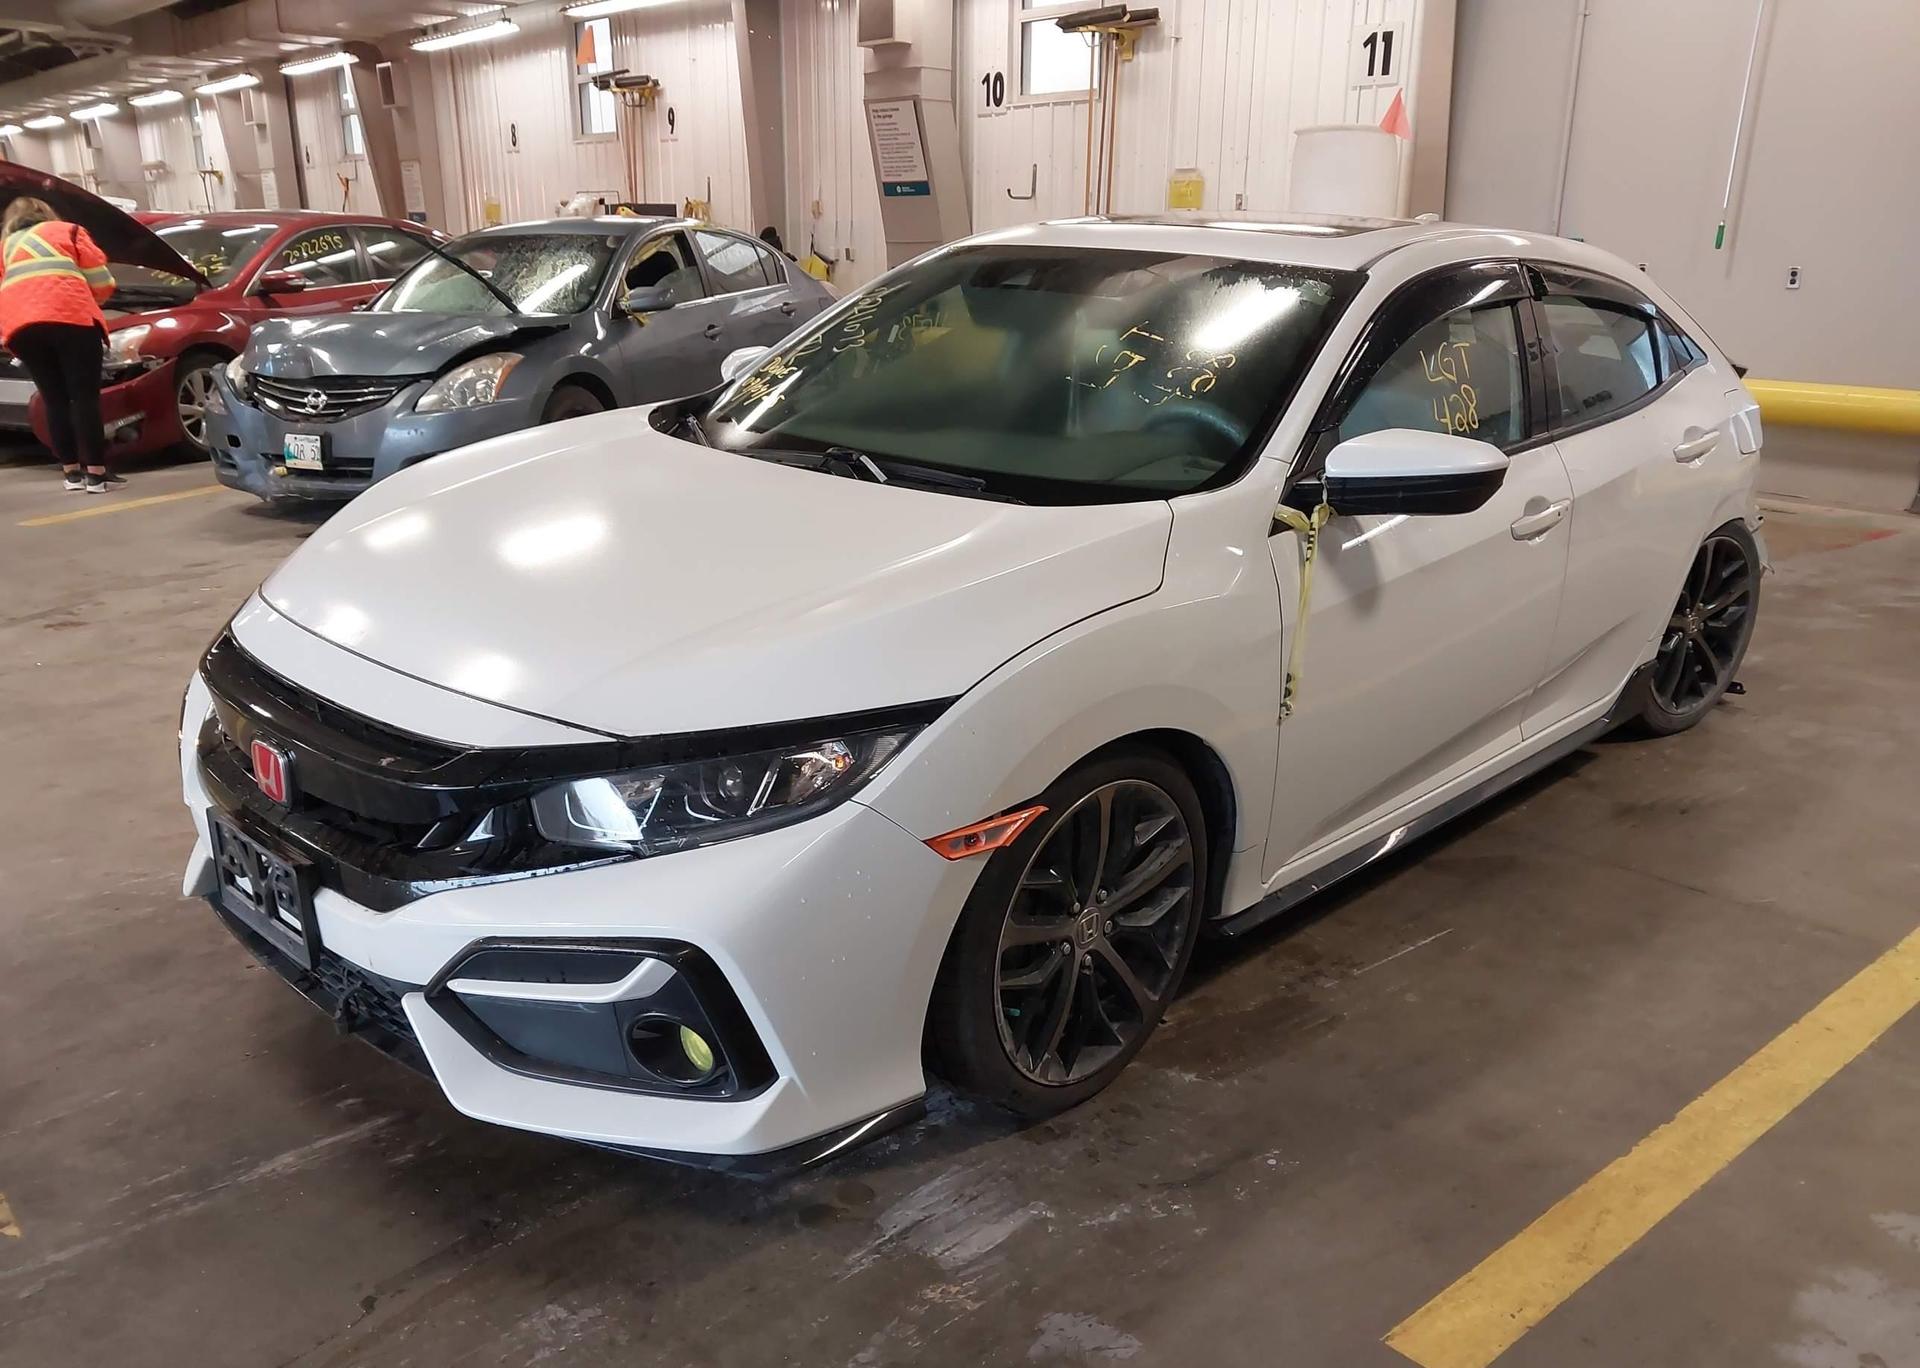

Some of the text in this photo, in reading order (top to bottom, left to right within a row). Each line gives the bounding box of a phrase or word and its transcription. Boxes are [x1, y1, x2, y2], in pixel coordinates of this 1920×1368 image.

[1363, 31, 1393, 76] 11
[982, 72, 1004, 107] 10
[511, 123, 517, 147] 8
[668, 107, 675, 135] 9
[1419, 341, 1471, 384] LGT
[1433, 384, 1479, 435] 428
